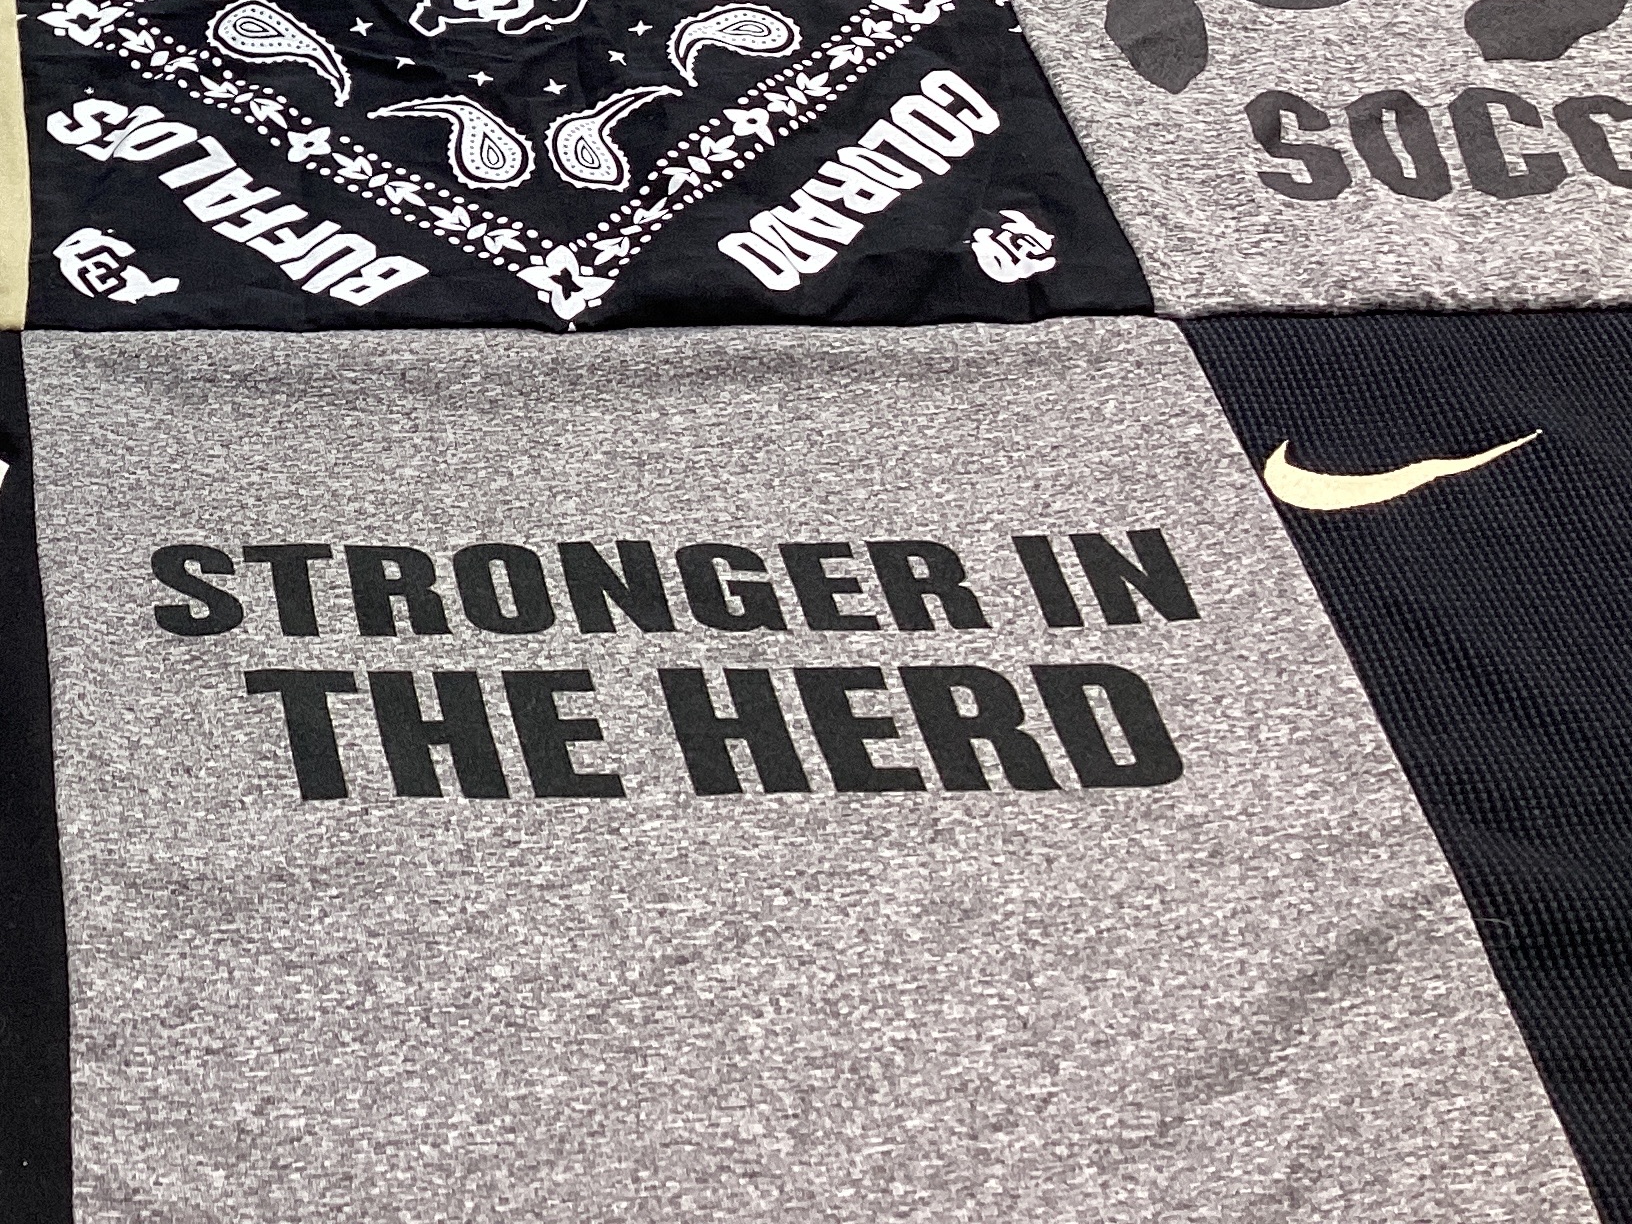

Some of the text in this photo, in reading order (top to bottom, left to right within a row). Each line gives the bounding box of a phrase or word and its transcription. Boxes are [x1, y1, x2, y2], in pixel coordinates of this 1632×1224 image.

[717, 69, 1001, 292] COLORADO
[150, 527, 1201, 638] STRONGER IN
[244, 662, 1185, 802] THE HERD
